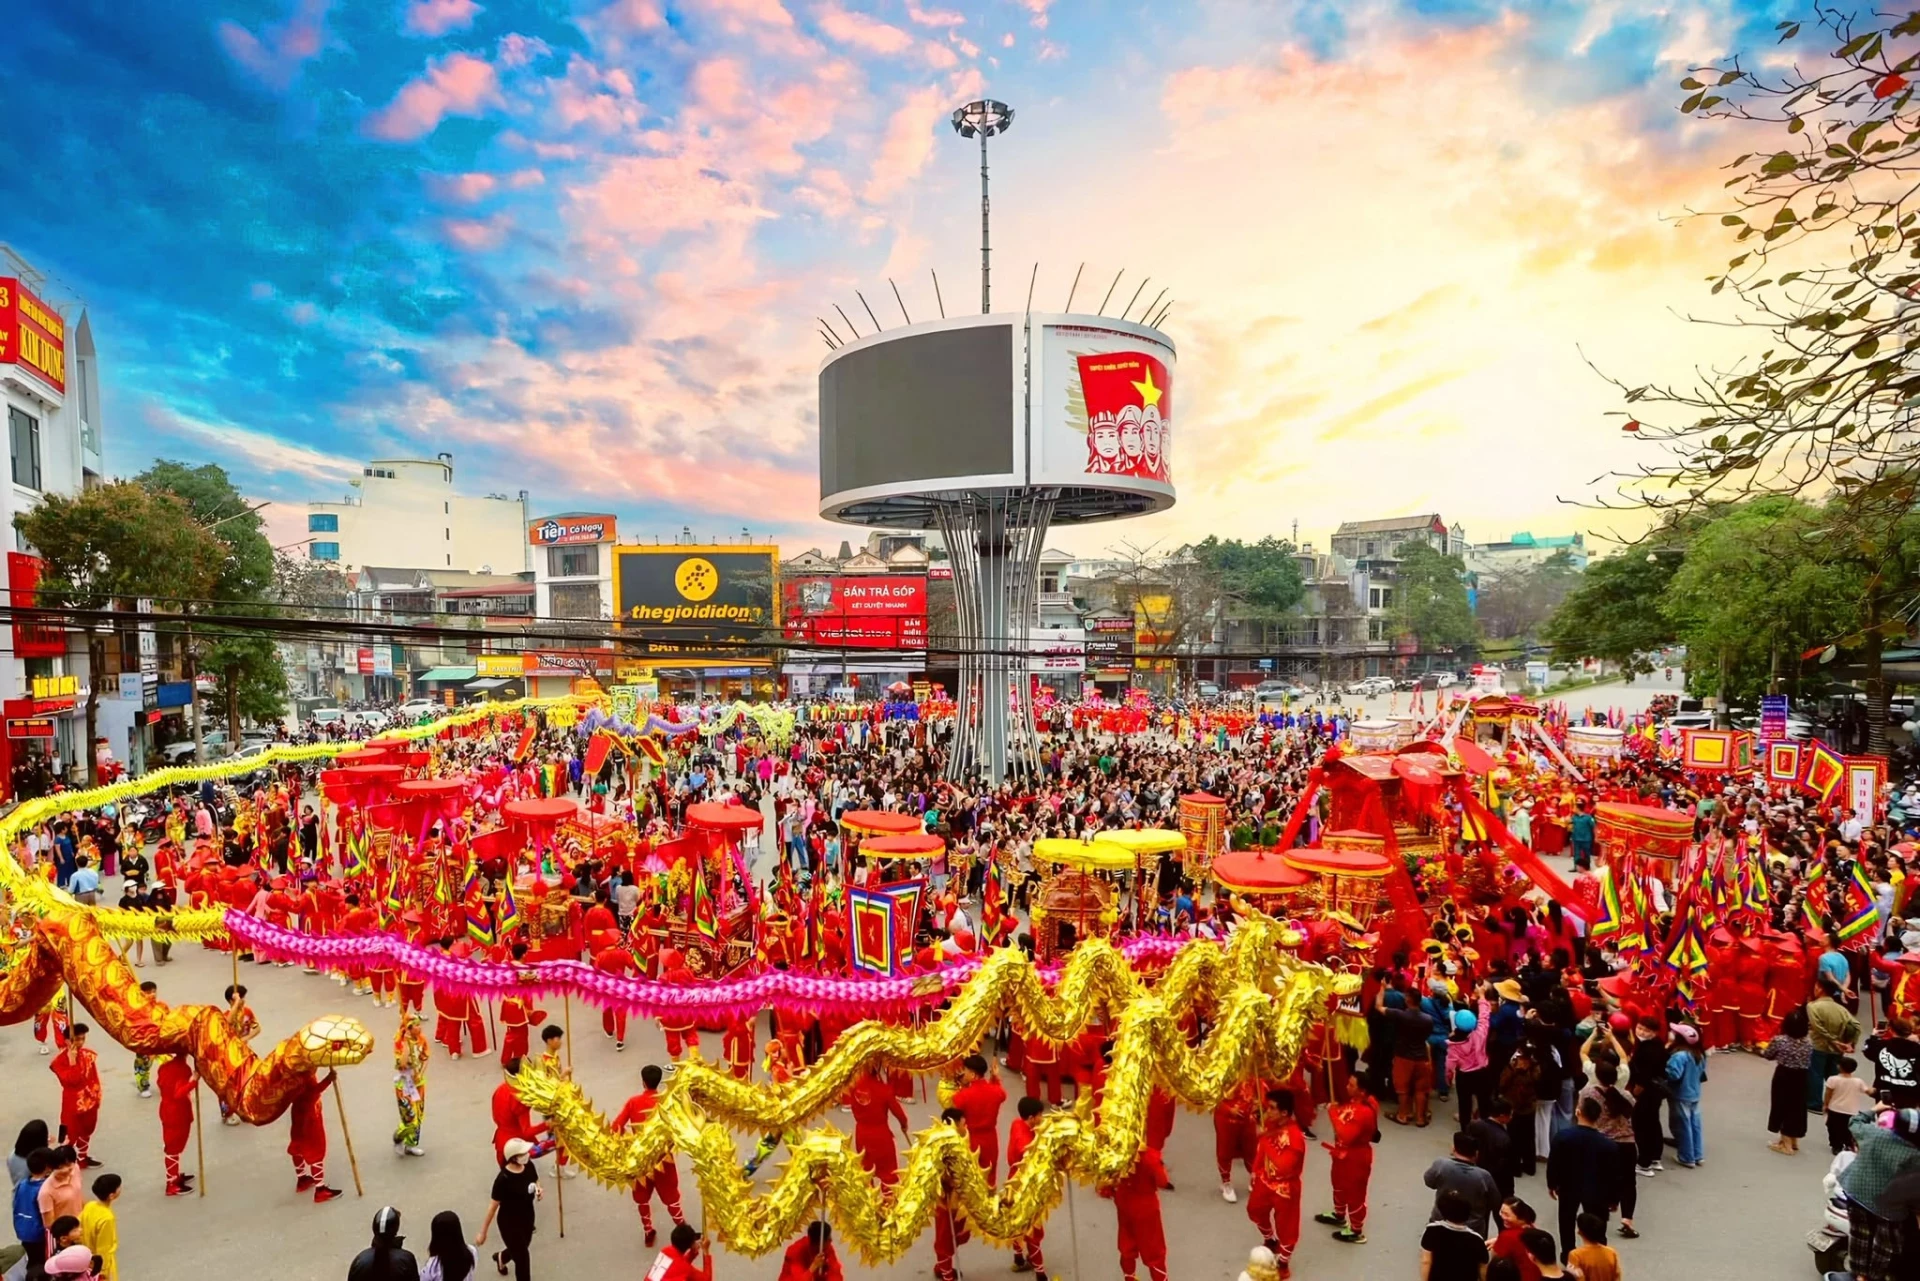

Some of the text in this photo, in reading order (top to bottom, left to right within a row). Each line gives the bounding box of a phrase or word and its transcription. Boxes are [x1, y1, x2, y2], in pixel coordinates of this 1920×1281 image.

[537, 521, 567, 540] Tiền
[581, 523, 603, 533] Ngay
[843, 584, 915, 597] BÁN TRẢ GÓP
